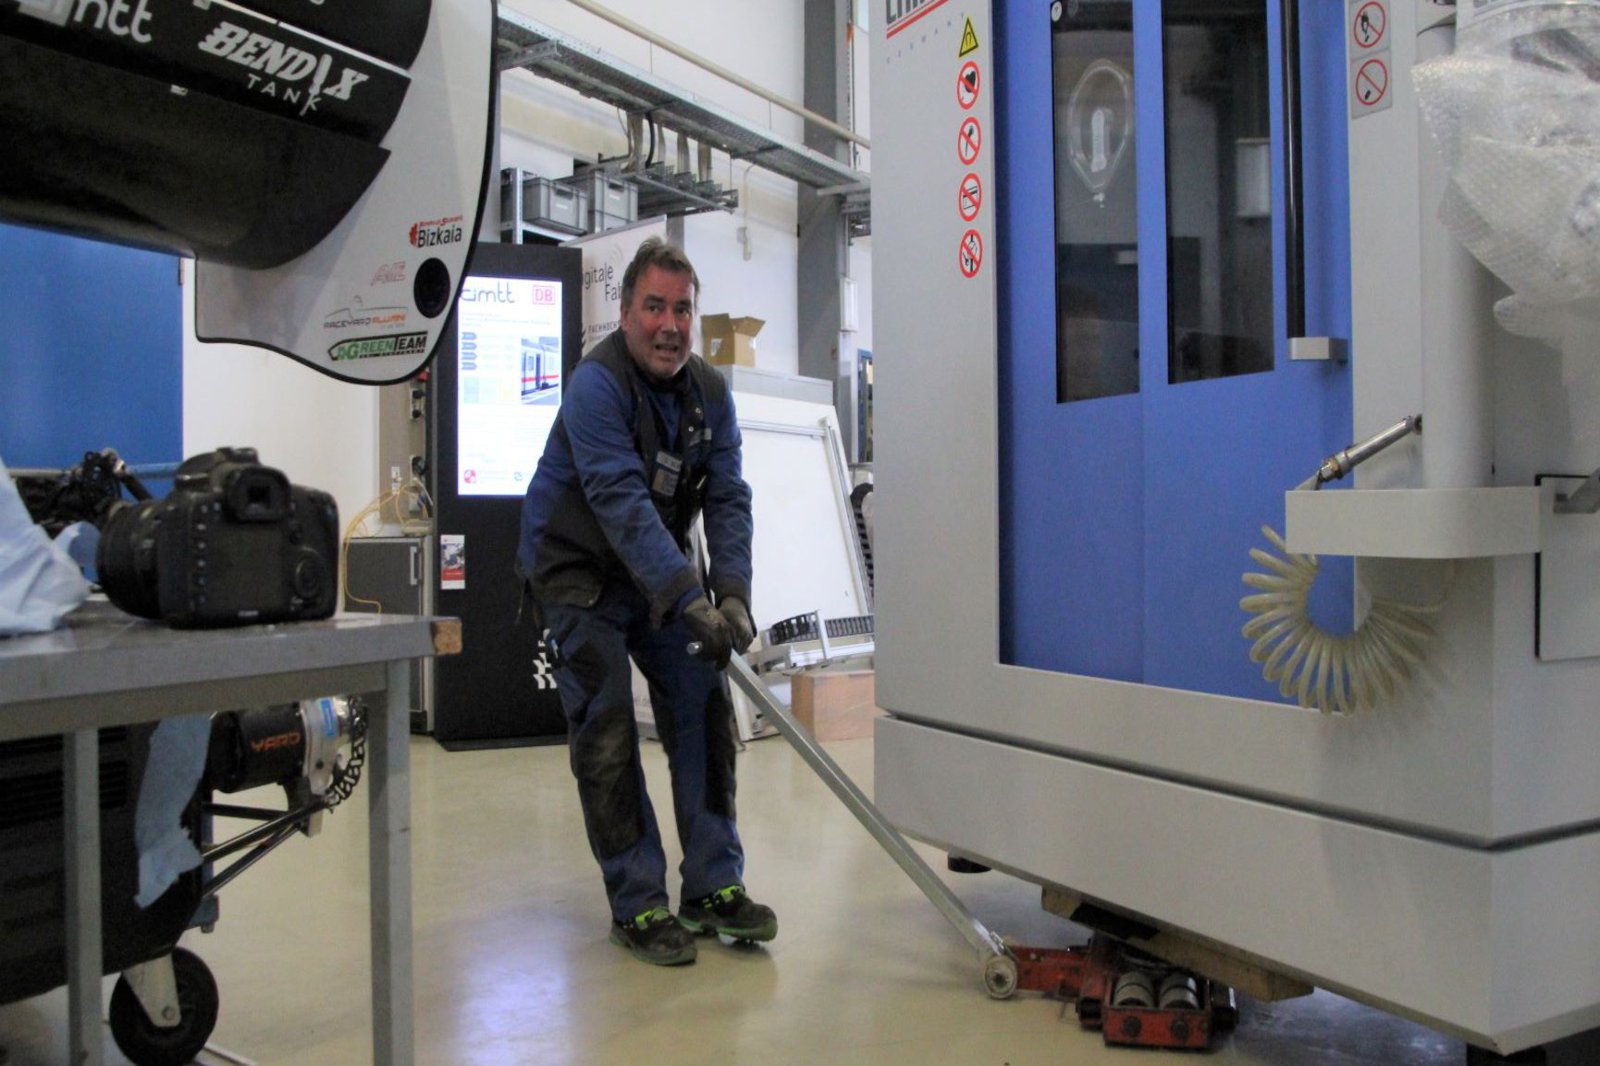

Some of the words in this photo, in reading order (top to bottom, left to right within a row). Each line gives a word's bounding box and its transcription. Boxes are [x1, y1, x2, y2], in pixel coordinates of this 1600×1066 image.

[198, 20, 371, 101] BENDIX
[247, 73, 322, 116] TANK
[418, 224, 462, 248] Bizkaia
[583, 262, 614, 291] gitale
[534, 287, 553, 303] DB
